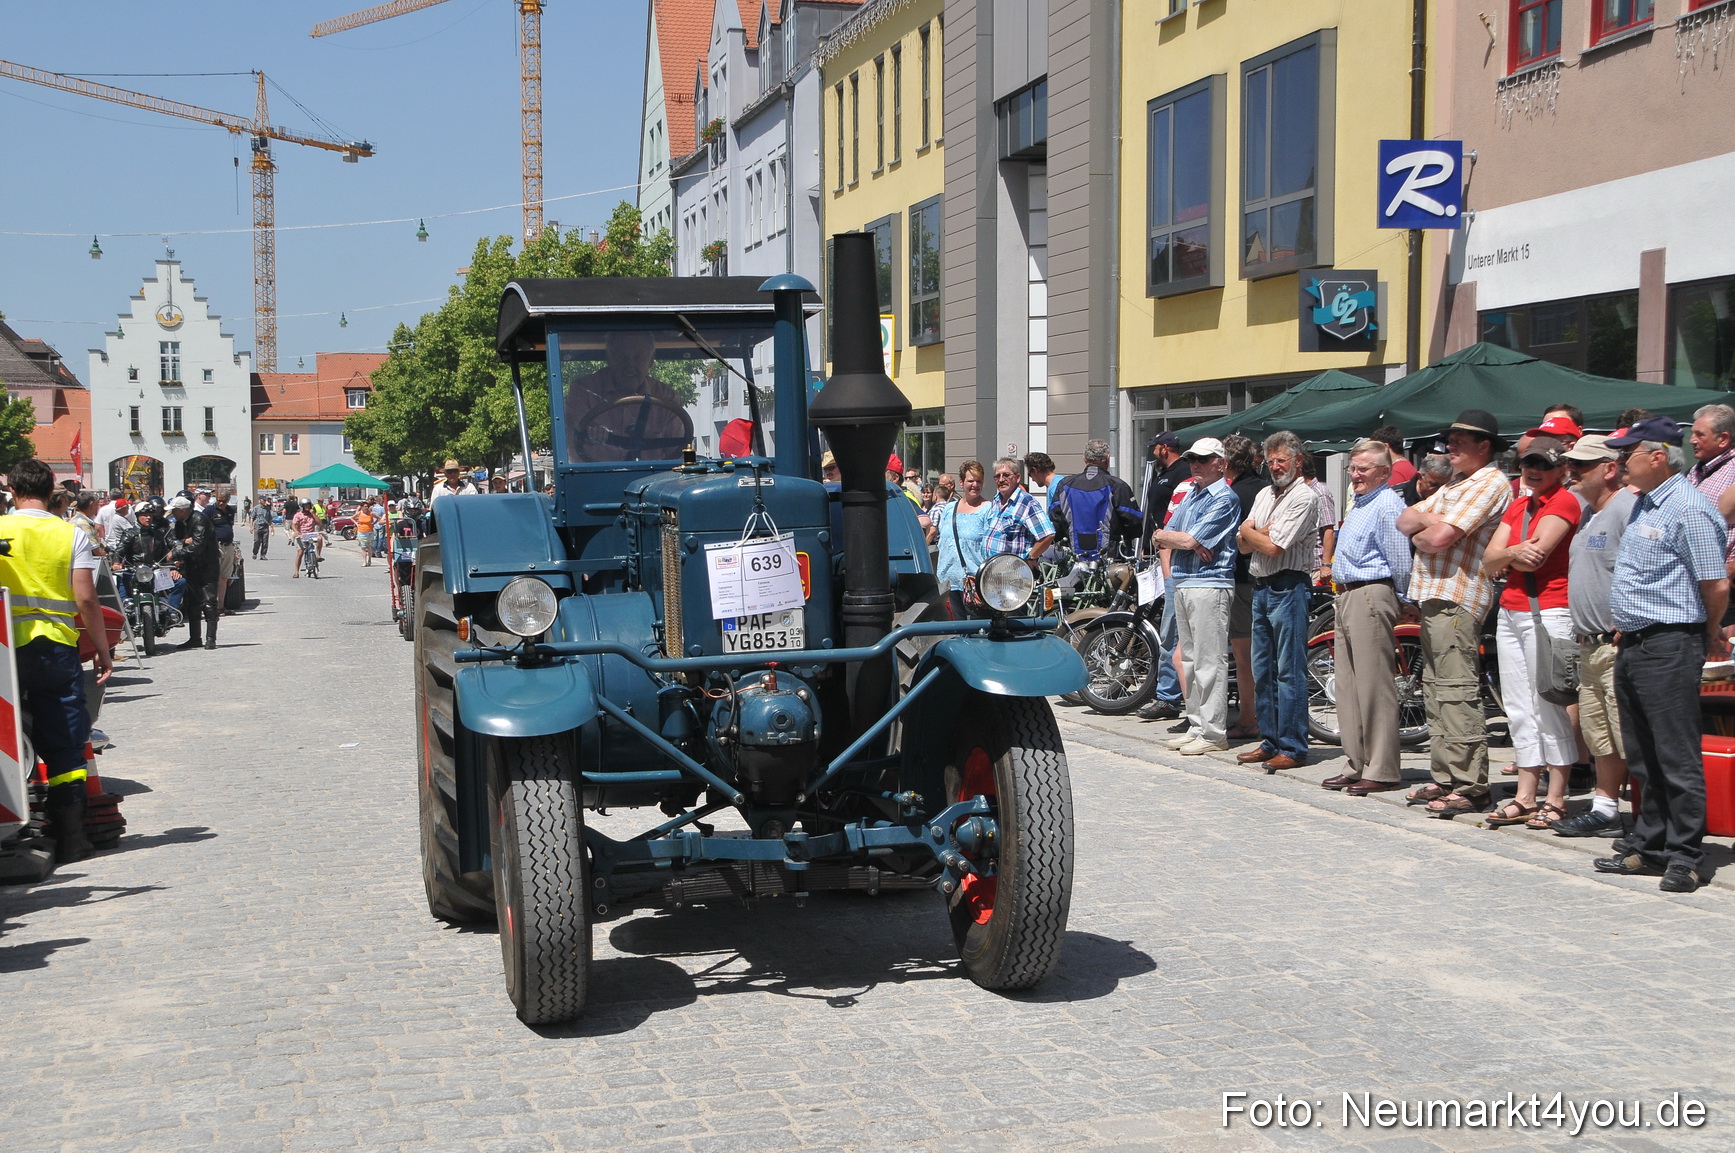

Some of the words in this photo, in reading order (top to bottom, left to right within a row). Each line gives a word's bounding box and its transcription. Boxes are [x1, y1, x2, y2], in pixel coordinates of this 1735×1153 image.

[1468, 254, 1495, 270] Unterer
[1497, 246, 1519, 265] Markt
[1521, 243, 1530, 260] 15
[1331, 292, 1358, 326] G2
[751, 554, 782, 572] 639
[737, 612, 773, 631] PAF
[727, 631, 788, 651] YG853
[789, 627, 801, 636] 03
[790, 639, 801, 648] 10
